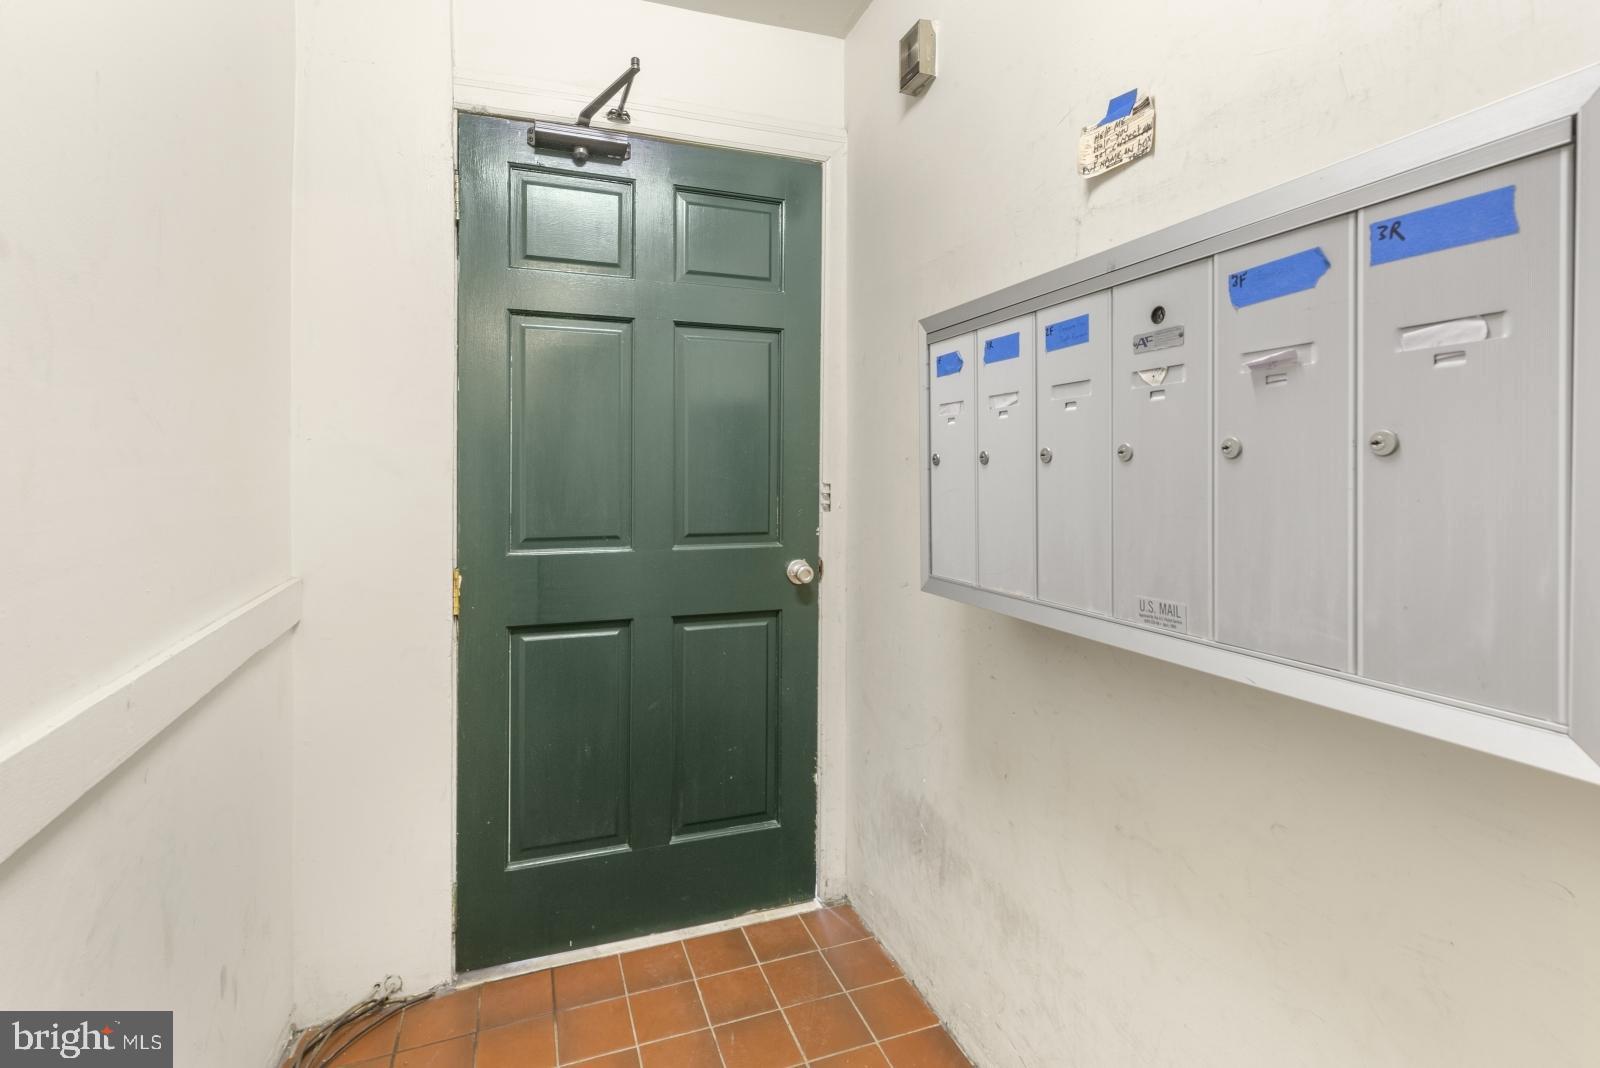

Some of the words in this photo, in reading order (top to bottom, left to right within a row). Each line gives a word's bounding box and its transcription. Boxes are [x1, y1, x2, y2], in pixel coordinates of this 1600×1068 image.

[1377, 220, 1406, 241] 3R
[1231, 270, 1248, 288] 3F
[1159, 602, 1182, 618] MAIL
